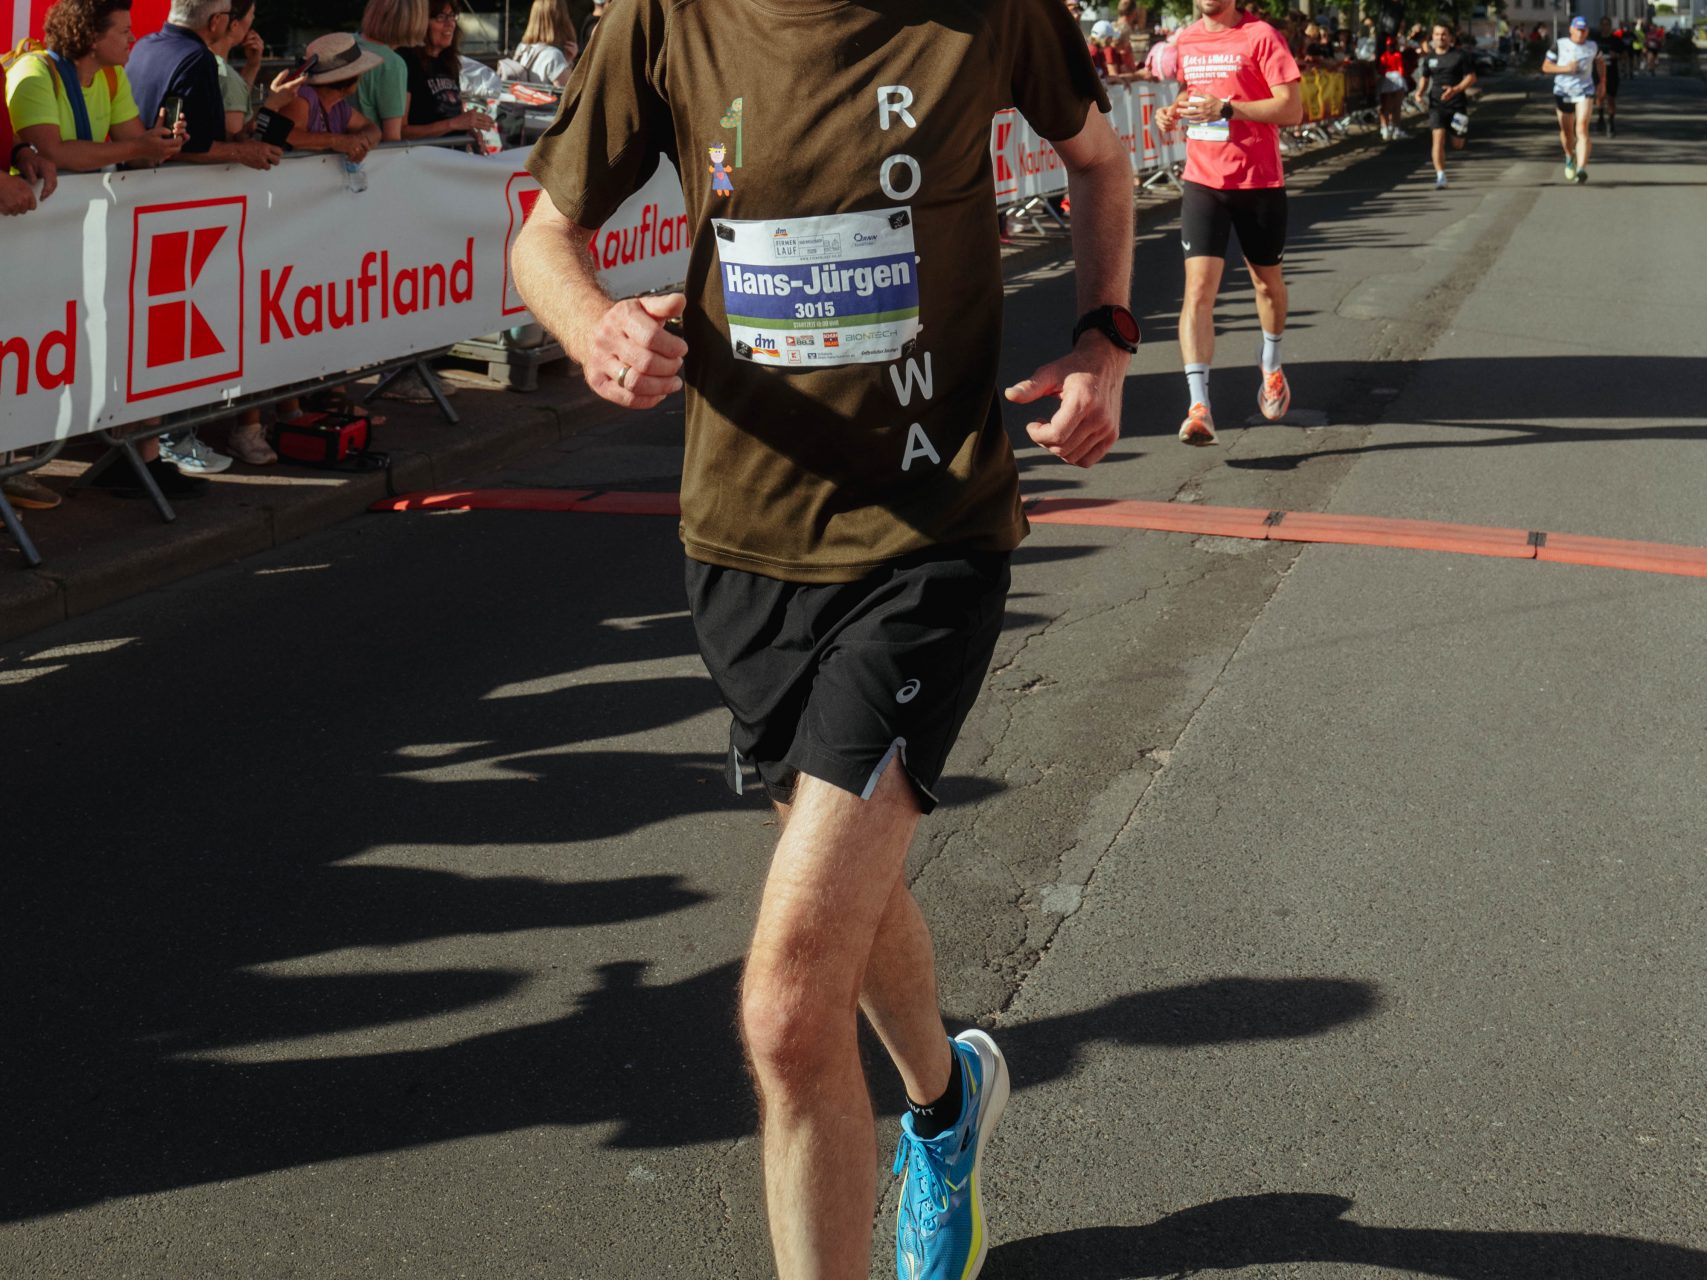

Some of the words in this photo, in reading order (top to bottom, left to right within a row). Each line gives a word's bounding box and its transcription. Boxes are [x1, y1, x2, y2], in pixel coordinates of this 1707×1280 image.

[777, 247, 797, 256] LAUF
[725, 261, 910, 297] Hans-Jürgen
[260, 237, 474, 344] Kaufland
[795, 301, 835, 318] 3015
[754, 333, 775, 350] dm
[845, 329, 898, 342] BIONTECH
